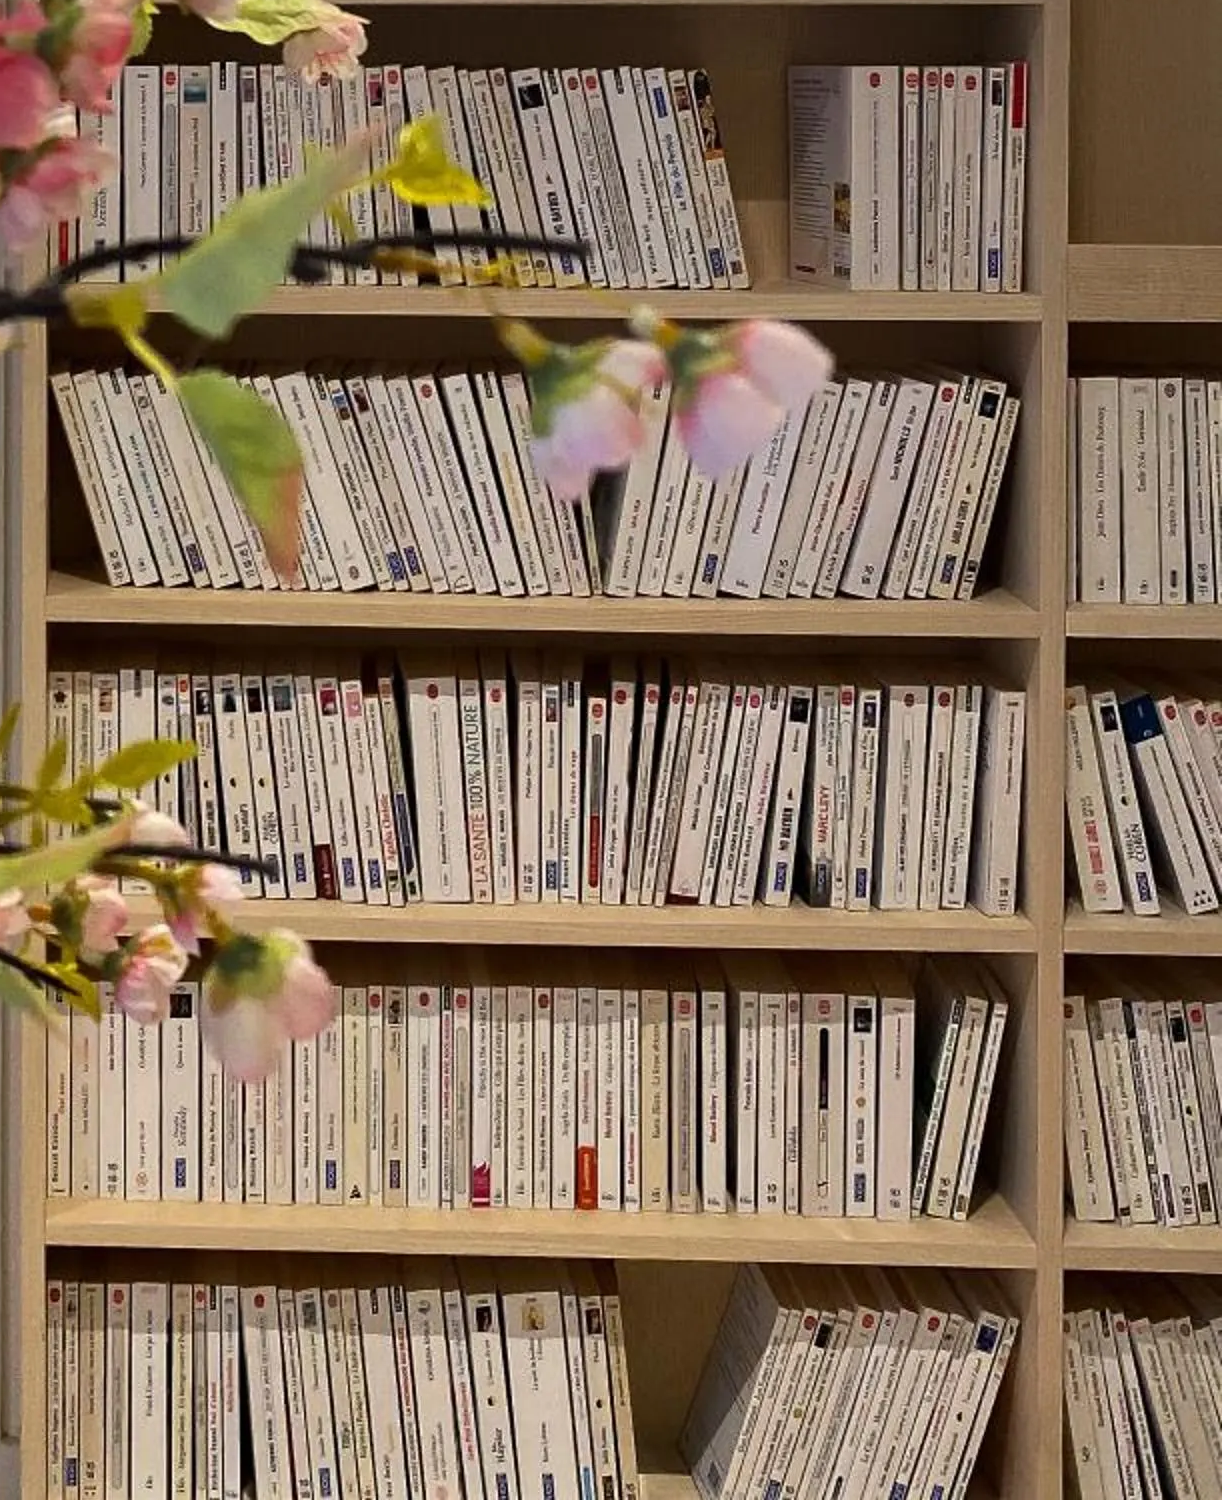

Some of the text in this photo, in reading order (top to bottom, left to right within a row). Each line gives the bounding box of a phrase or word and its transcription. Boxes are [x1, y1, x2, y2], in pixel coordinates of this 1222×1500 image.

[464, 705, 488, 883] LA SANTÉ 100% NATURE
[818, 784, 830, 842] MARC LEVY
